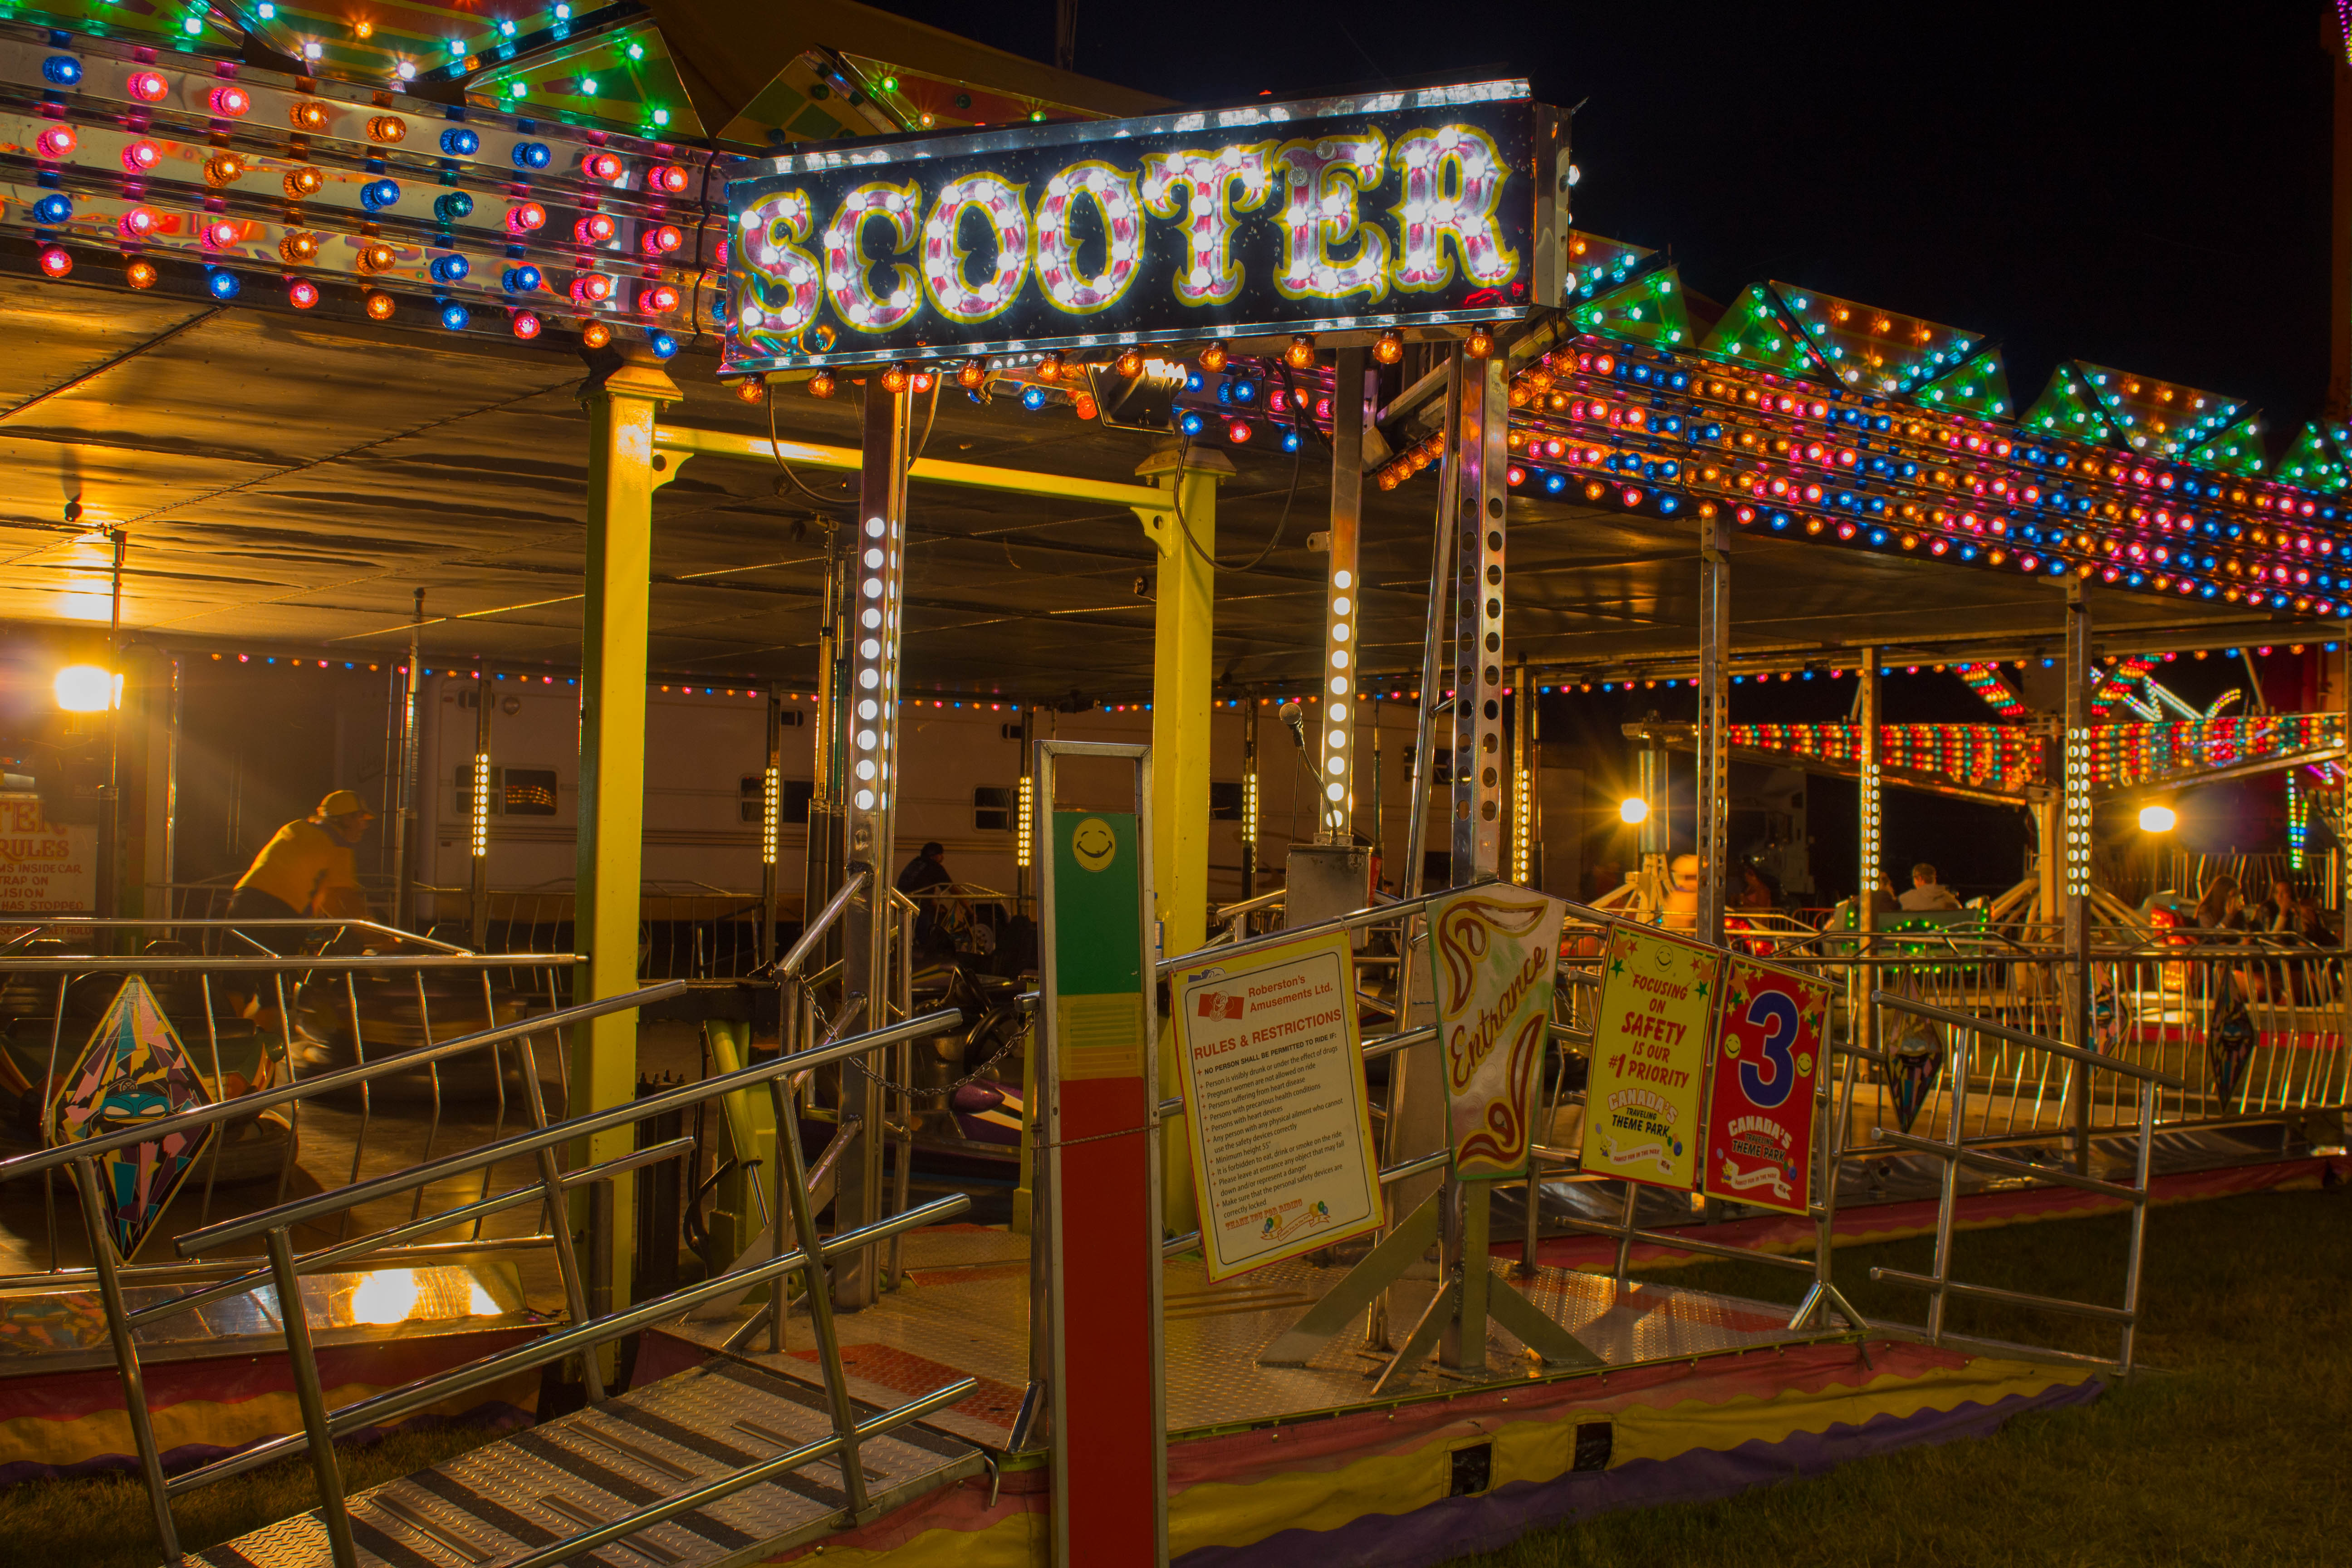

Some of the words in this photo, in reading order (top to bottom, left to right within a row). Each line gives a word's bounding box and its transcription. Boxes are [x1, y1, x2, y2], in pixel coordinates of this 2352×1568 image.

[736, 122, 1520, 347] SCOOTER
[18, 863, 56, 873] INSIDE
[58, 863, 83, 874] CAR
[32, 876, 49, 885] ON
[1, 901, 25, 910] HAS
[29, 901, 84, 911] STOPPED
[1248, 975, 1305, 997] Roberston's
[1250, 989, 1312, 1013] Amusements
[1314, 982, 1333, 995] Ltd.
[1632, 974, 1688, 1000] FOCUSING
[1449, 946, 1548, 1091] Entrance
[1649, 998, 1666, 1014] ON
[1194, 1038, 1236, 1060] RULES
[1240, 1034, 1249, 1047] &
[1252, 1009, 1341, 1044] RESTRICTIONS
[1621, 1011, 1687, 1046] SAFETY
[1204, 1067, 1214, 1075] NO
[1214, 1059, 1240, 1072] PERSON
[1240, 1054, 1260, 1064] SHALL
[1260, 1051, 1269, 1059] BE
[1270, 1041, 1304, 1056] PERMITTED
[1314, 1034, 1328, 1044] RIDE
[1632, 1040, 1645, 1056] IS
[1646, 1044, 1671, 1063] OUR
[1738, 990, 1799, 1108] 3
[1205, 1078, 1225, 1088] Person
[1230, 1070, 1249, 1081] visibly
[1249, 1065, 1266, 1076] drunk
[1273, 1059, 1289, 1069] under
[1290, 1056, 1299, 1064] the
[1300, 1051, 1316, 1061] effect
[1316, 1048, 1322, 1057] of
[1322, 1045, 1338, 1054] drugs
[1206, 1086, 1233, 1099] Pregnant
[1233, 1081, 1254, 1092] women
[1254, 1078, 1264, 1086] are
[1264, 1074, 1274, 1083] not
[1275, 1067, 1296, 1079] allowed
[1305, 1062, 1316, 1071] ride
[1608, 1053, 1627, 1078] #1
[1627, 1060, 1690, 1088] PRIORITY
[1208, 1099, 1230, 1110] Persons
[1230, 1092, 1255, 1103] suffering
[1256, 1087, 1269, 1096] from
[1270, 1082, 1285, 1092] heart
[1285, 1077, 1305, 1087] disease
[1210, 1110, 1232, 1121] Persons
[1232, 1104, 1245, 1114] with
[1245, 1097, 1274, 1112] precarious
[1274, 1091, 1292, 1102] health
[1293, 1083, 1321, 1096] conditions
[1608, 1088, 1679, 1125] CANADA'S
[1211, 1121, 1233, 1132] Persons
[1233, 1115, 1246, 1125] with
[1246, 1111, 1262, 1121] heart
[1262, 1105, 1283, 1116] devices
[1212, 1134, 1224, 1143] Any
[1225, 1128, 1244, 1140] person
[1244, 1123, 1257, 1133] with
[1269, 1112, 1291, 1127] physical
[1291, 1107, 1312, 1118] ailment
[1312, 1103, 1324, 1112] who
[1324, 1098, 1343, 1108] cannot
[1612, 1114, 1643, 1132] THEME
[1645, 1121, 1670, 1138] PARK
[1626, 1107, 1657, 1120] TRAVELING
[1235, 1137, 1252, 1147] safety
[1252, 1131, 1273, 1142] devices
[1274, 1122, 1297, 1135] correctly
[1728, 1115, 1793, 1149] CANADA'S
[1746, 1133, 1774, 1146] TRAVELING
[1215, 1152, 1243, 1164] Minimum
[1243, 1145, 1261, 1156] height
[1218, 1176, 1237, 1186] Please
[1237, 1171, 1252, 1180] leave
[1259, 1161, 1284, 1173] entrance
[1284, 1157, 1294, 1165] any
[1294, 1151, 1312, 1162] object
[1312, 1147, 1323, 1156] that
[1324, 1144, 1335, 1152] may
[1336, 1139, 1344, 1148] fall
[1227, 1159, 1255, 1171] forbidden
[1274, 1147, 1289, 1157] drink
[1295, 1140, 1313, 1151] smoke
[1331, 1130, 1342, 1139] ride
[1732, 1139, 1761, 1157] THEME
[1763, 1147, 1786, 1164] PARK
[1220, 1187, 1236, 1196] down
[1237, 1181, 1255, 1191] and/or
[1256, 1171, 1283, 1185] represent
[1287, 1164, 1306, 1175] danger
[1221, 1197, 1237, 1207] Make
[1238, 1194, 1250, 1202] sure
[1250, 1189, 1262, 1198] that
[1263, 1186, 1272, 1194] the
[1273, 1177, 1296, 1192] personal
[1297, 1173, 1313, 1183] safety
[1313, 1166, 1333, 1177] devices
[1223, 1205, 1248, 1218] correctly
[1248, 1198, 1267, 1210] locked
[1225, 1216, 1250, 1230] THANK
[1249, 1211, 1263, 1223] YOU
[1264, 1206, 1278, 1218] FOR
[1278, 1198, 1303, 1213] RIDING
